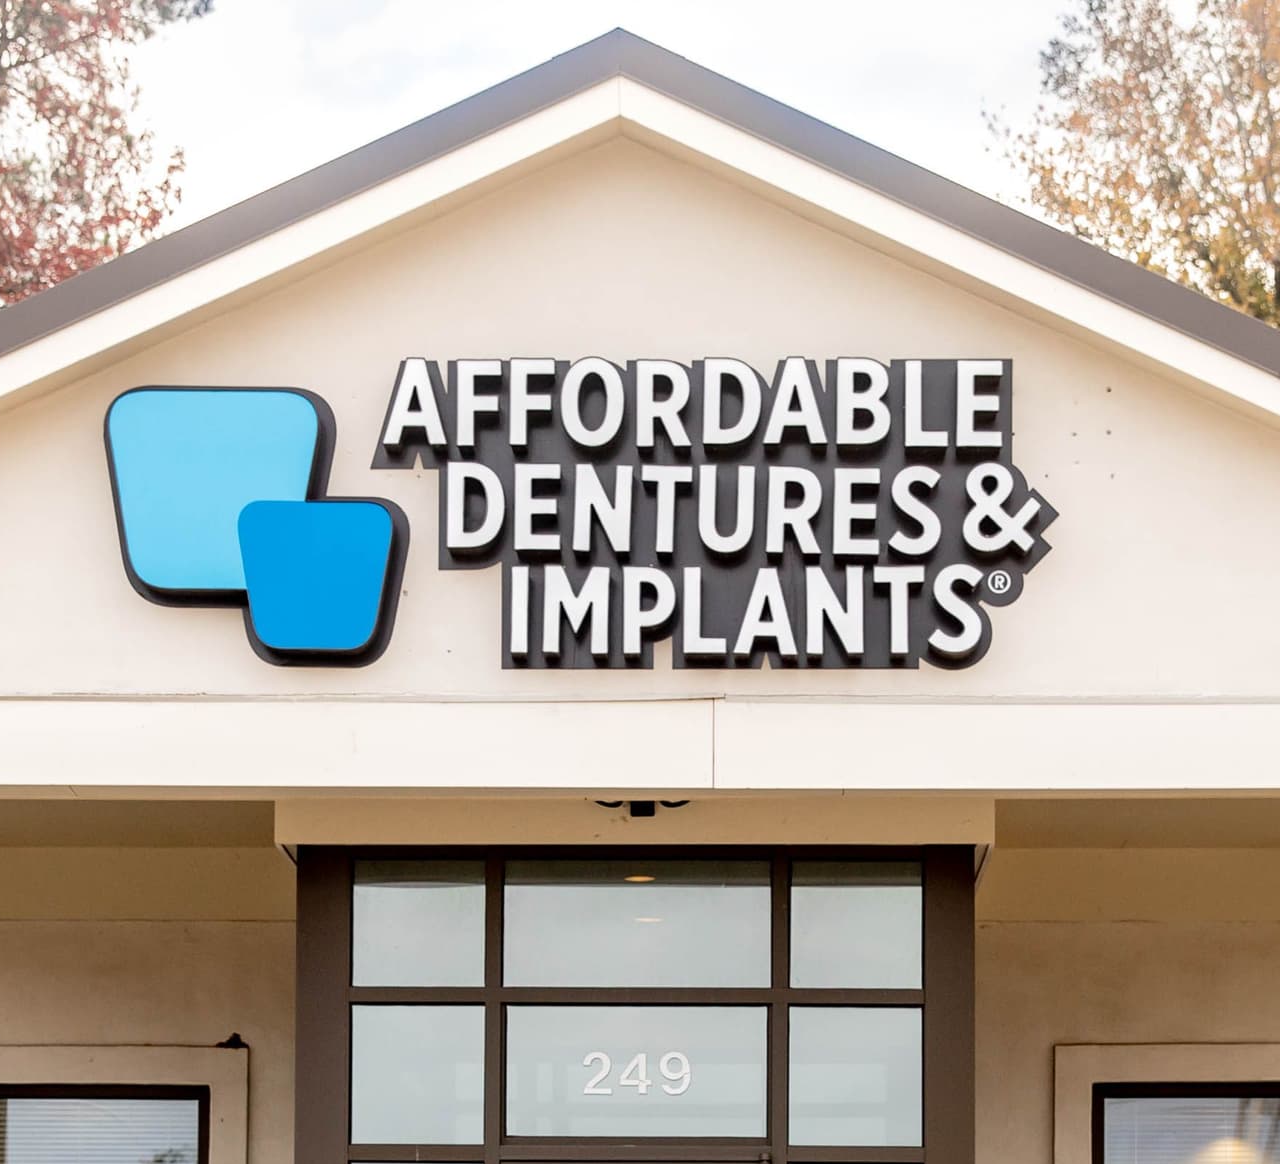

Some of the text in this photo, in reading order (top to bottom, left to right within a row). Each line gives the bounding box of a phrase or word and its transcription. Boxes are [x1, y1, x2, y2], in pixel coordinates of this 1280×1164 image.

[382, 355, 1004, 449] AFFORDABLE
[446, 462, 1041, 556] DENTURES &
[582, 1050, 692, 1096] 249
